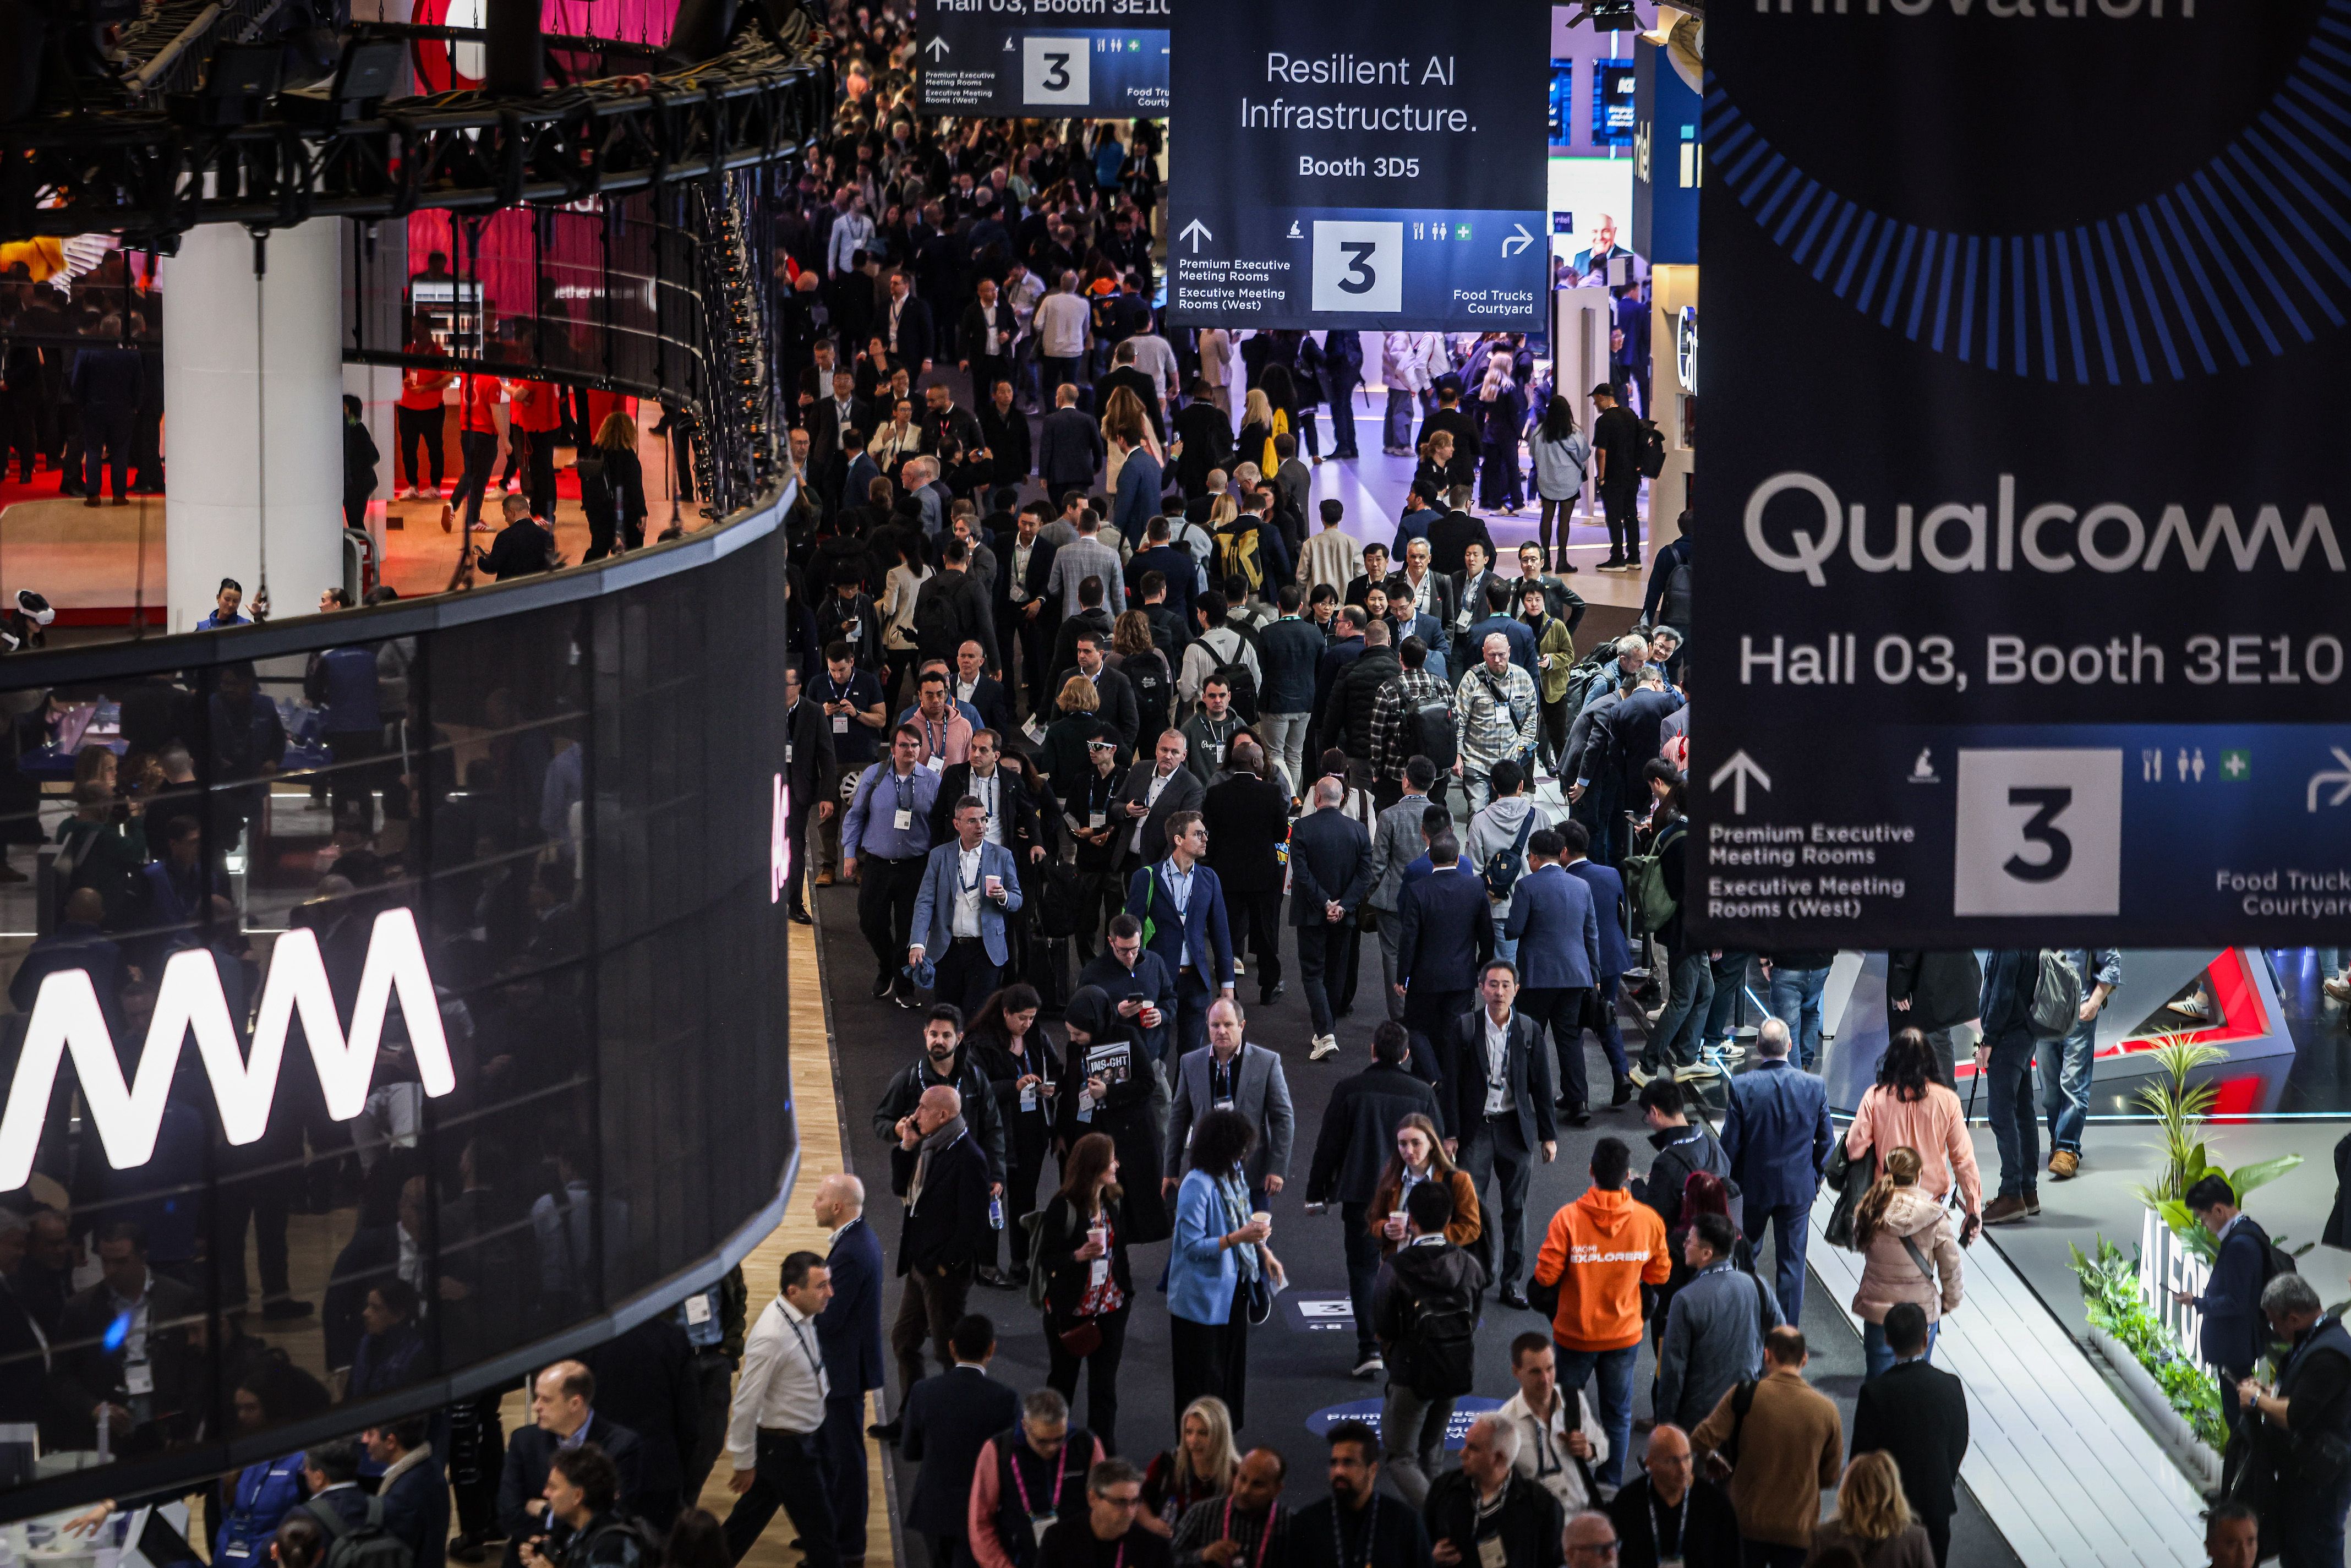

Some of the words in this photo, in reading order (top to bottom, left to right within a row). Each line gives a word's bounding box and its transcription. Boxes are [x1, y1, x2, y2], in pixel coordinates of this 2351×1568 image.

[1034, 0, 1106, 14] Booth
[1042, 53, 1070, 92] 3
[1268, 53, 1410, 86] Resilient
[1421, 57, 1455, 86] AI
[962, 90, 993, 98] Meeting
[1127, 88, 1152, 96] Food
[1155, 88, 1169, 96] Tru
[1138, 98, 1169, 108] Courty
[1242, 99, 1477, 133] Infrastructure.
[1300, 156, 1366, 177] Booth
[1374, 158, 1420, 178] 3D5
[1180, 259, 1231, 270] Premium
[1235, 260, 1291, 271] Executive
[1338, 242, 1376, 295] 3
[1180, 271, 1226, 283] Meeting
[1230, 272, 1270, 282] Rooms
[1180, 288, 1235, 298] Executive
[1239, 289, 1286, 301] Meeting
[1454, 290, 1487, 301] Food
[1491, 291, 1533, 302] Trucks
[1179, 300, 1219, 310] Rooms
[1222, 301, 1262, 312] (West)
[1468, 303, 1533, 316] Courtyard
[1744, 472, 2346, 587] Qualcomm
[1741, 635, 1856, 685] Hall
[1874, 636, 1968, 693] 03,
[1987, 635, 2164, 685] Booth
[2185, 636, 2344, 685] 3E10
[1710, 826, 1805, 844] Premium
[1812, 825, 1915, 843] Executive
[2003, 786, 2073, 884] 3
[1710, 846, 1796, 867] Meeting
[1803, 846, 1876, 865] Rooms
[1709, 878, 1812, 897] Executive
[1820, 878, 1905, 898] Meeting
[2217, 872, 2278, 891] Food
[2288, 871, 2351, 891] Truck
[1709, 900, 1781, 919] Rooms
[1789, 900, 1861, 919] (West)
[2243, 896, 2351, 919] Courtyar
[1570, 1250, 1649, 1264] EXPLORERS
[1571, 1245, 1598, 1254] XIAOMI
